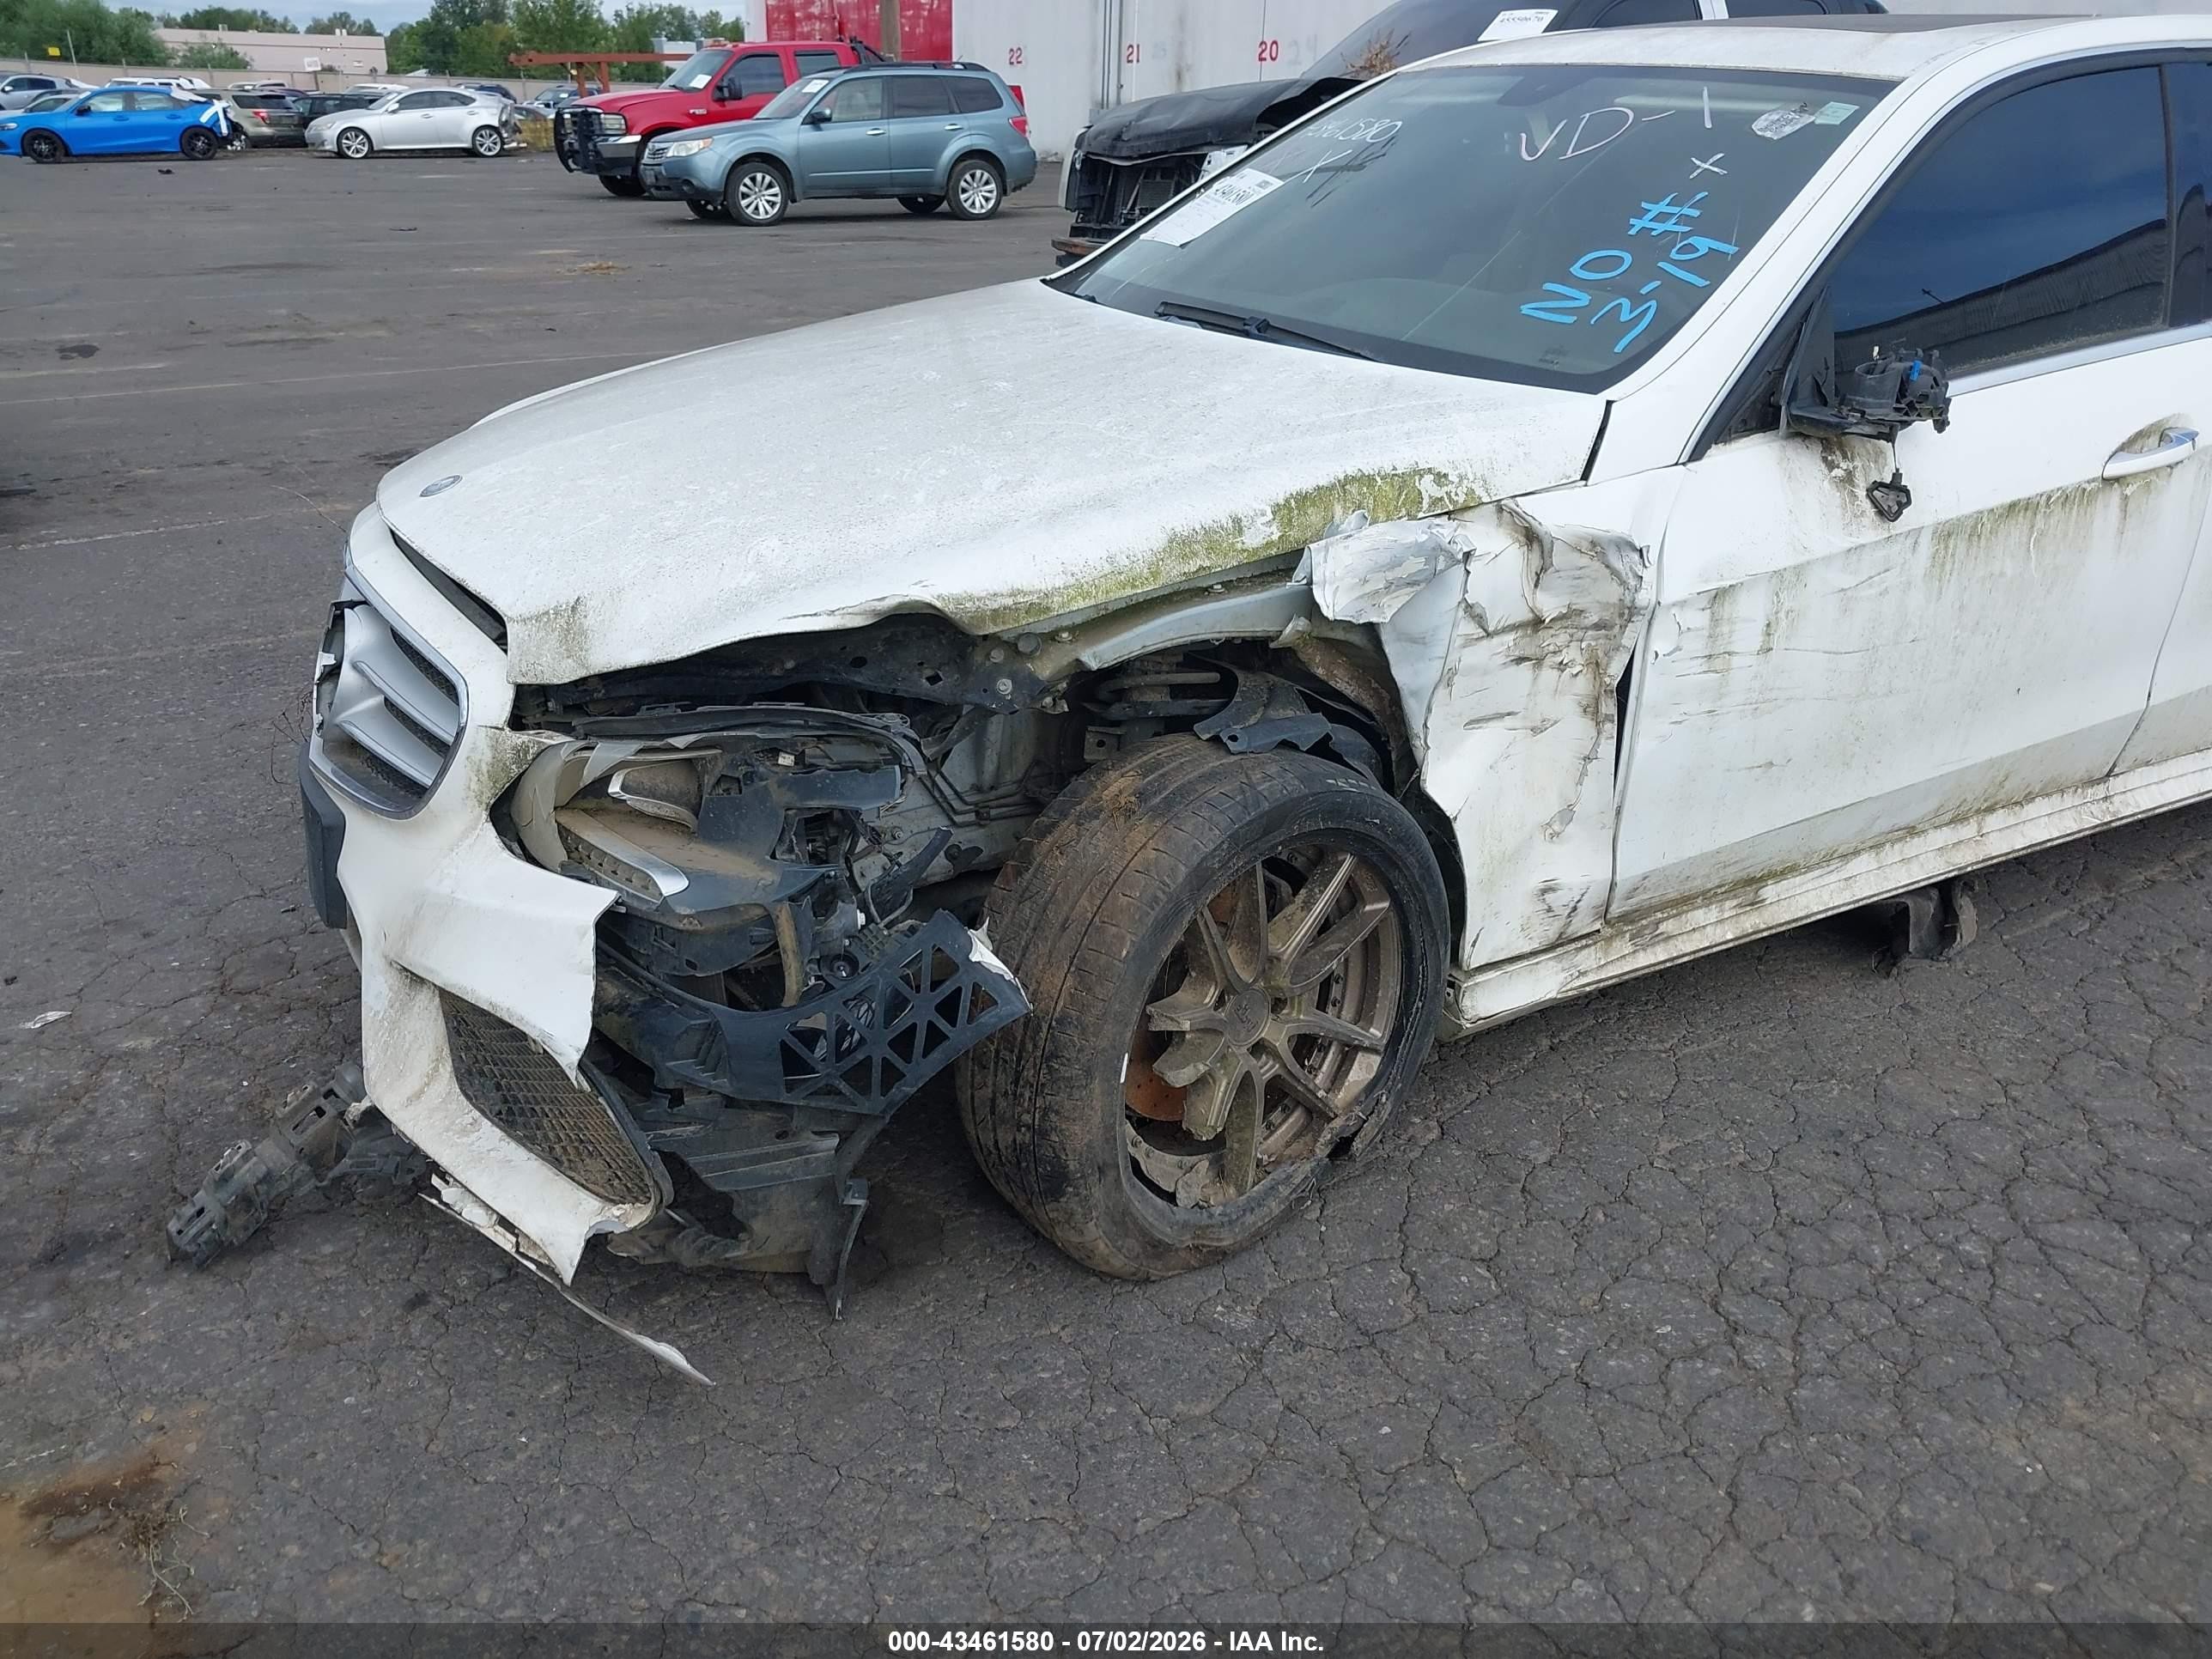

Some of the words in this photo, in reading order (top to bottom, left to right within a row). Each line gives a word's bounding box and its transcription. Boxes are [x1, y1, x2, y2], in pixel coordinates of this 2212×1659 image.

[1008, 46, 1024, 67] 22
[1126, 43, 1140, 65] 21
[1258, 40, 1279, 62] 20
[1520, 249, 1632, 324] NO
[1627, 191, 1709, 235] #
[1590, 236, 1740, 353] 3-19
